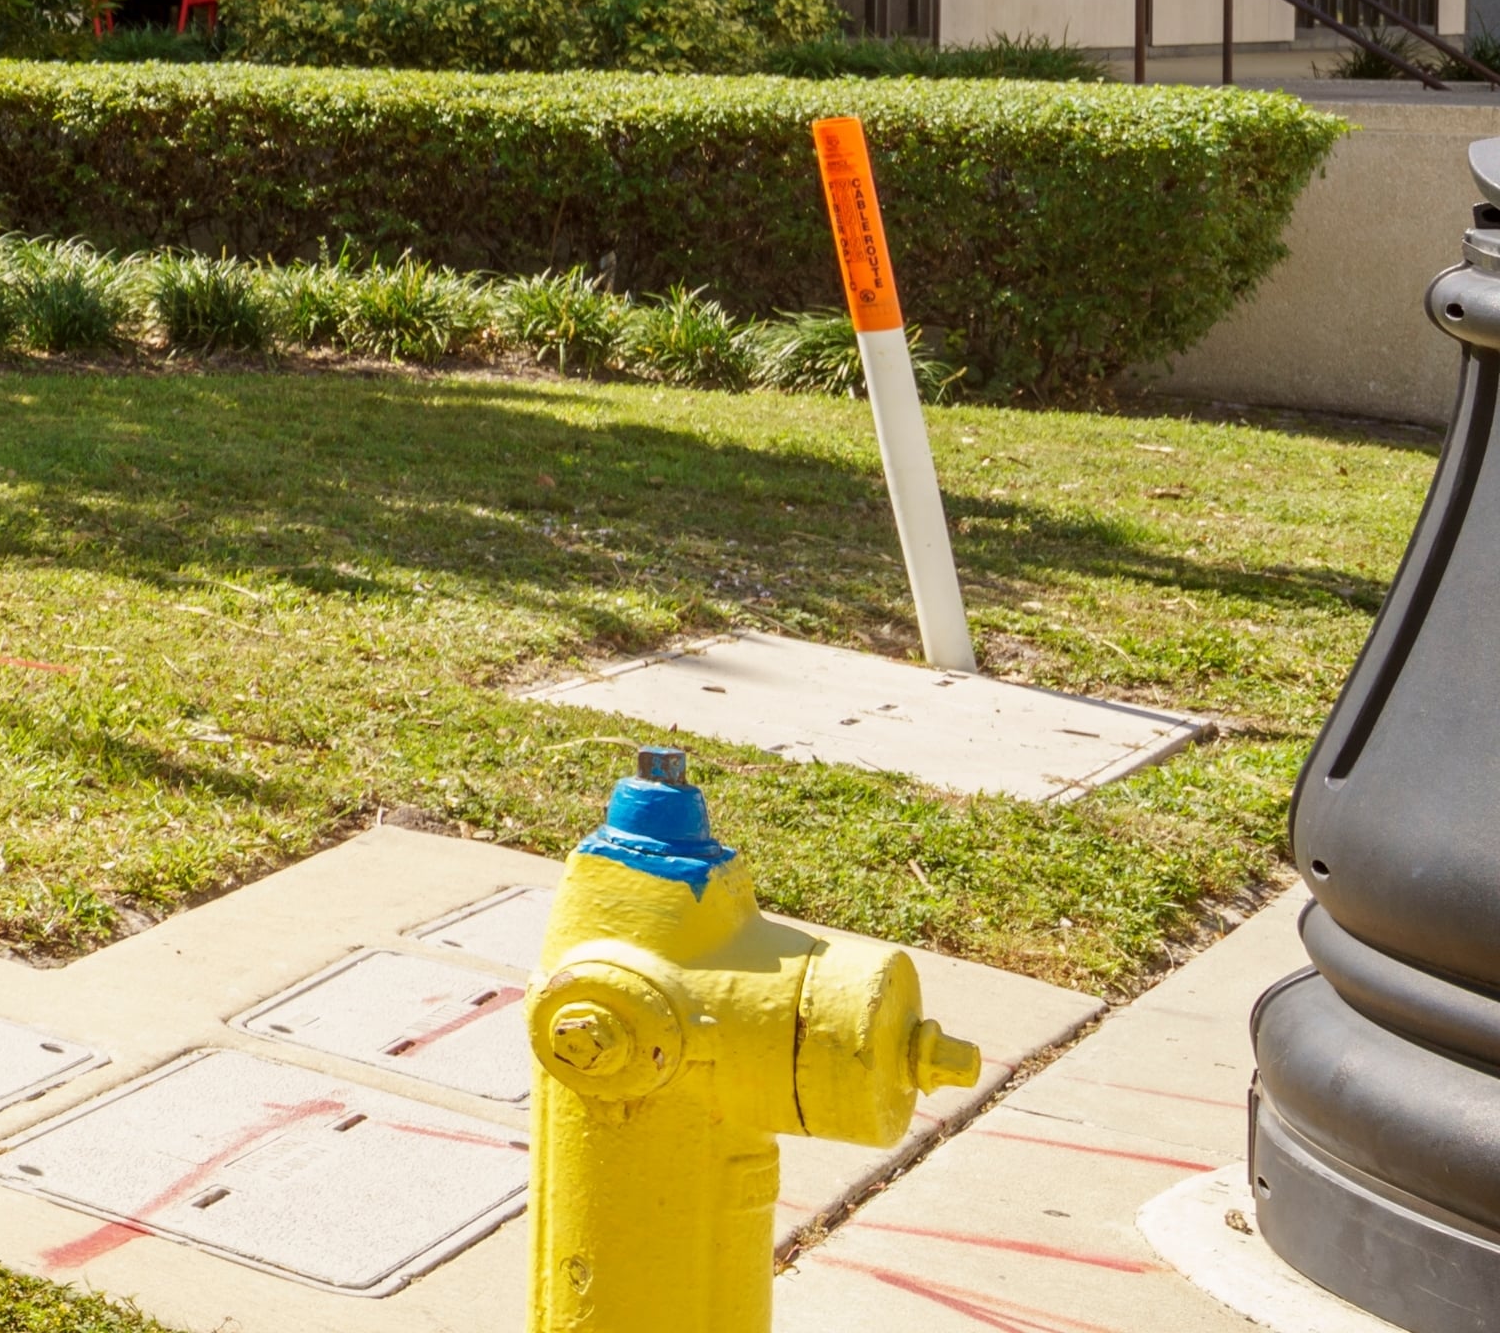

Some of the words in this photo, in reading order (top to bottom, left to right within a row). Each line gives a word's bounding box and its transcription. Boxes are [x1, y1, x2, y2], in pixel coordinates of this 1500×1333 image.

[827, 181, 845, 235] FIBER
[850, 177, 872, 232] CABLE
[862, 234, 884, 289] ROUTE
